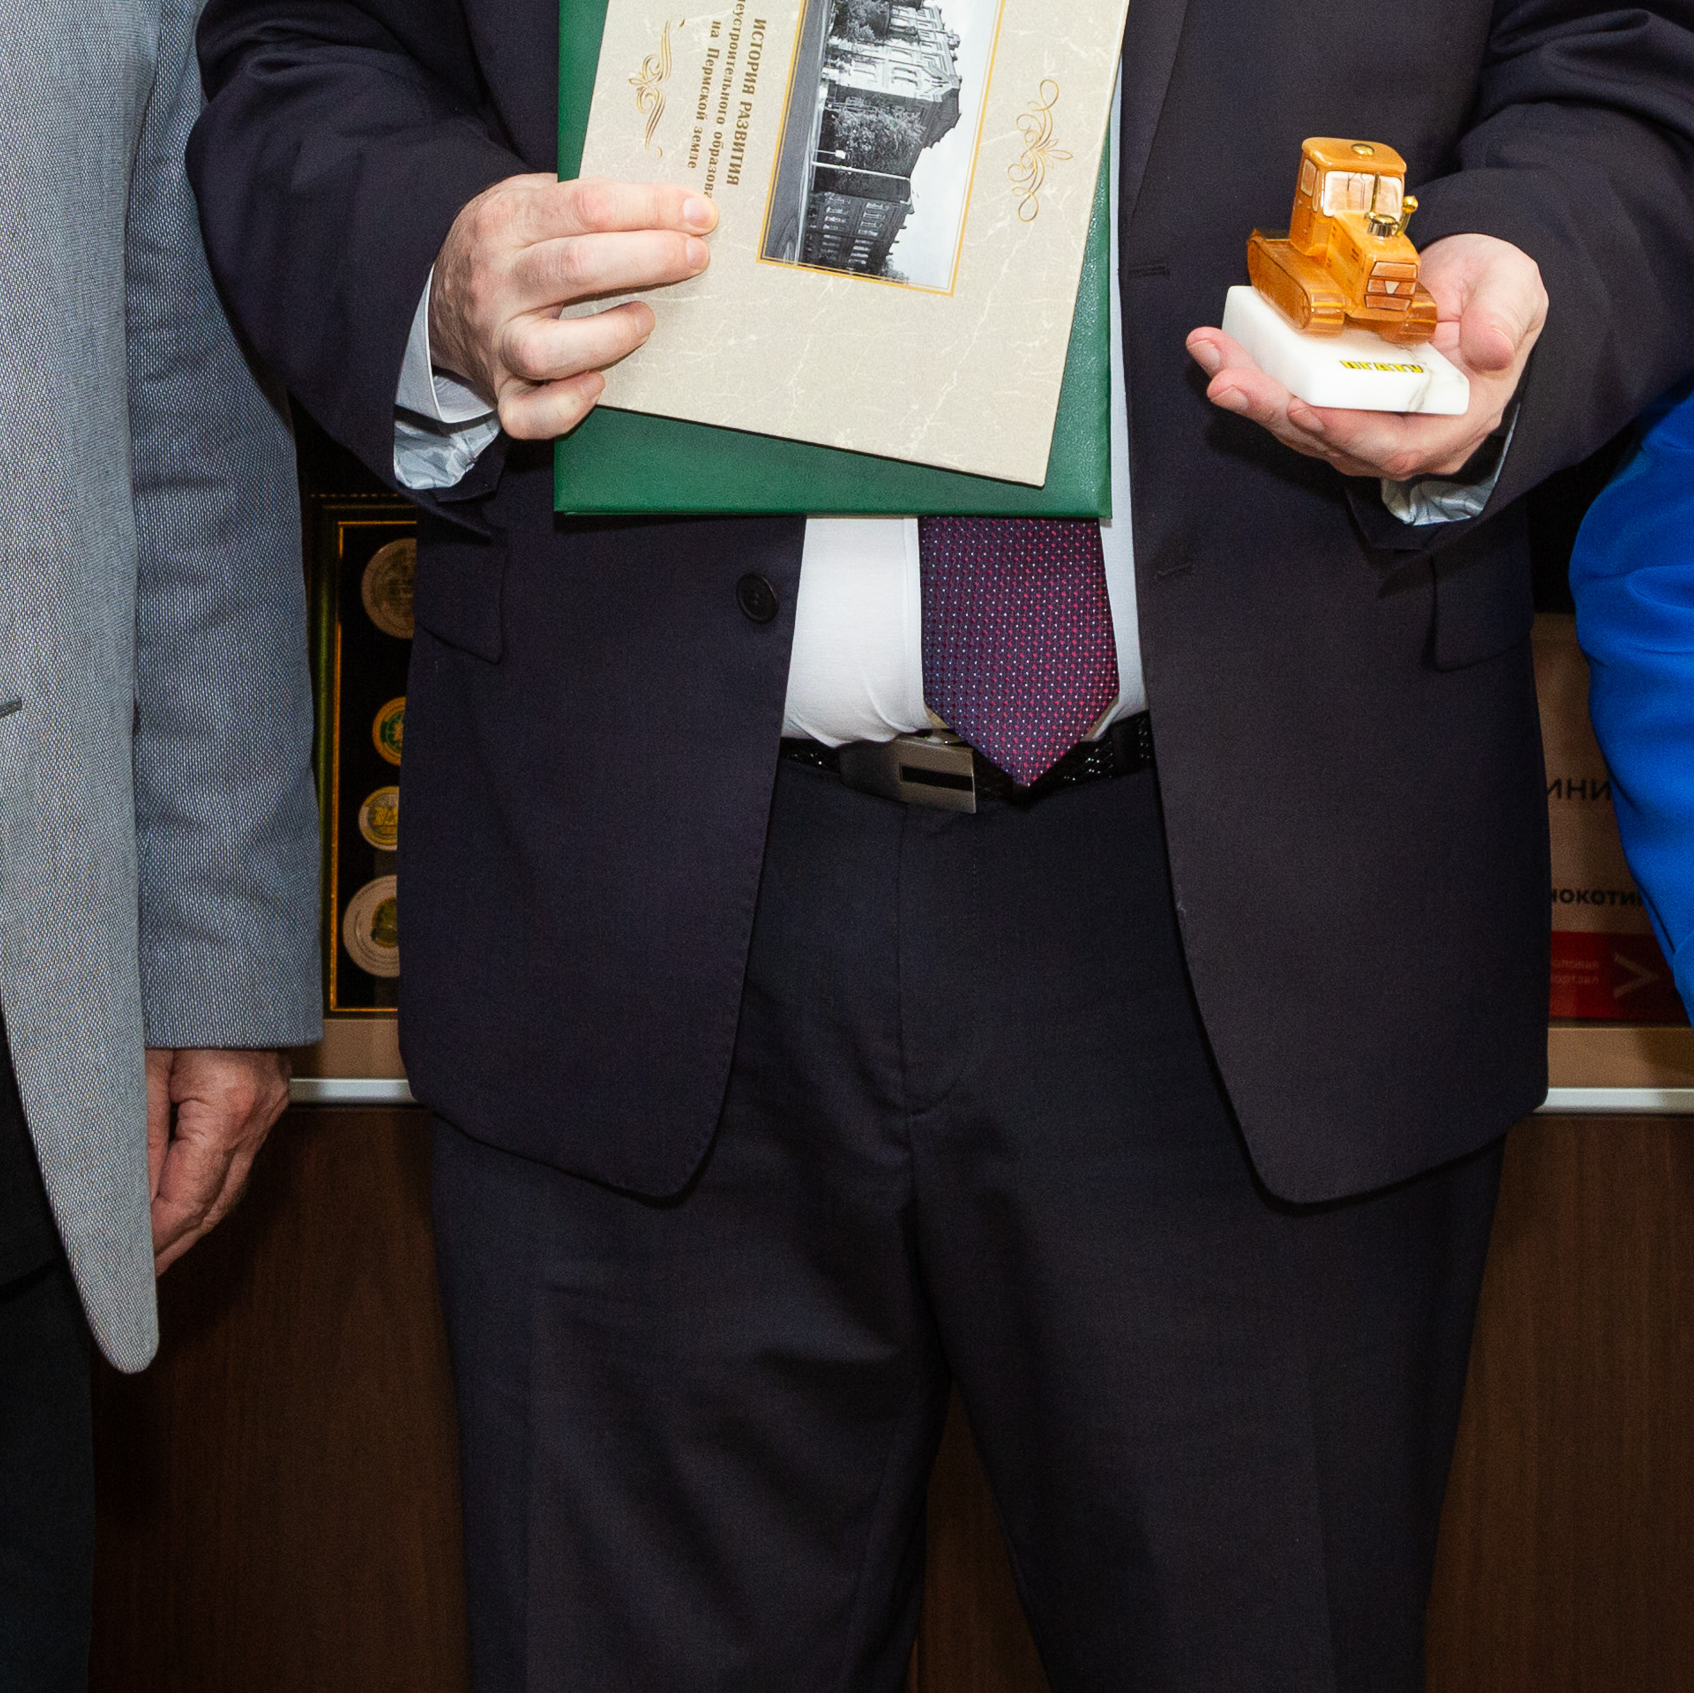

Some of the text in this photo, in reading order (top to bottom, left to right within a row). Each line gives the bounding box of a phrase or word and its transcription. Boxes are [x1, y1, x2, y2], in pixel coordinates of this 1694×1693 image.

[687, 21, 722, 169] на Пермской земле
[704, 132, 723, 199] образова
[726, 18, 767, 186] ИСТОРИЯ РАЗВИТИЯ
